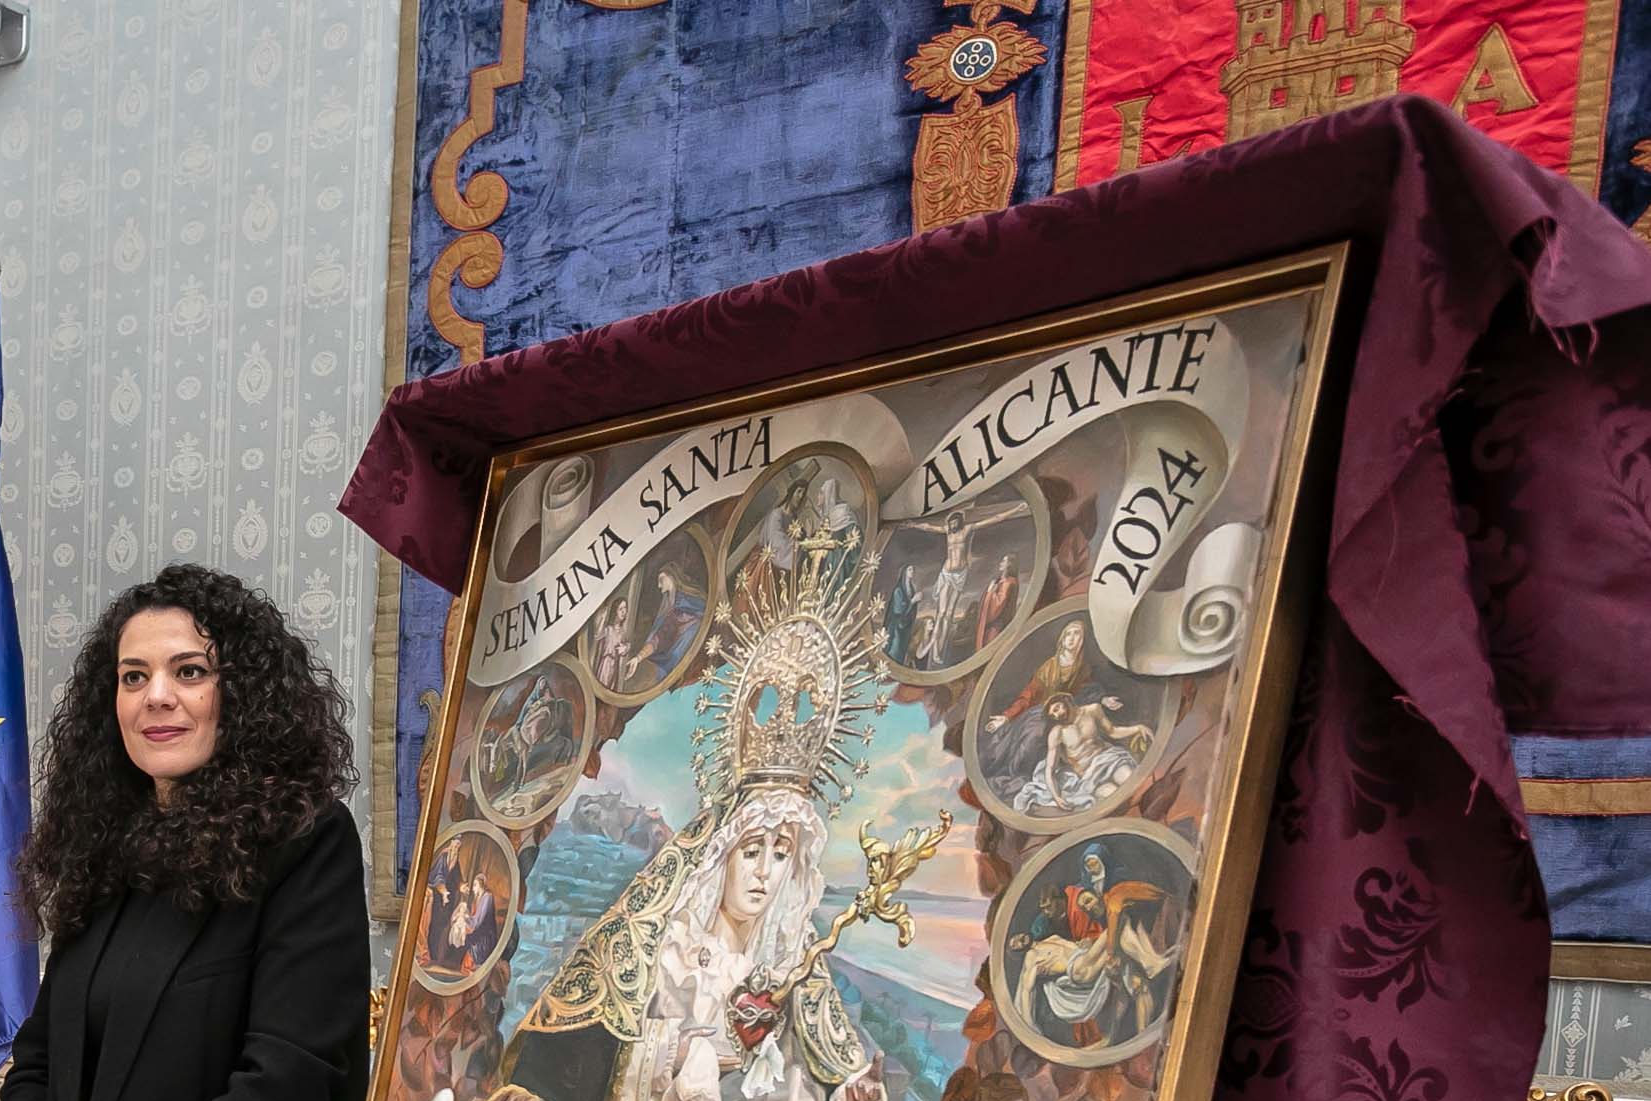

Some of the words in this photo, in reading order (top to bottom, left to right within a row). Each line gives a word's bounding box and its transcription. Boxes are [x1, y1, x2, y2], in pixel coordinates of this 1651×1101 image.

[919, 320, 1217, 516] ALICANTE
[484, 523, 634, 661] SEMANA
[640, 416, 775, 530] SANTA
[1094, 446, 1208, 598] 2024
